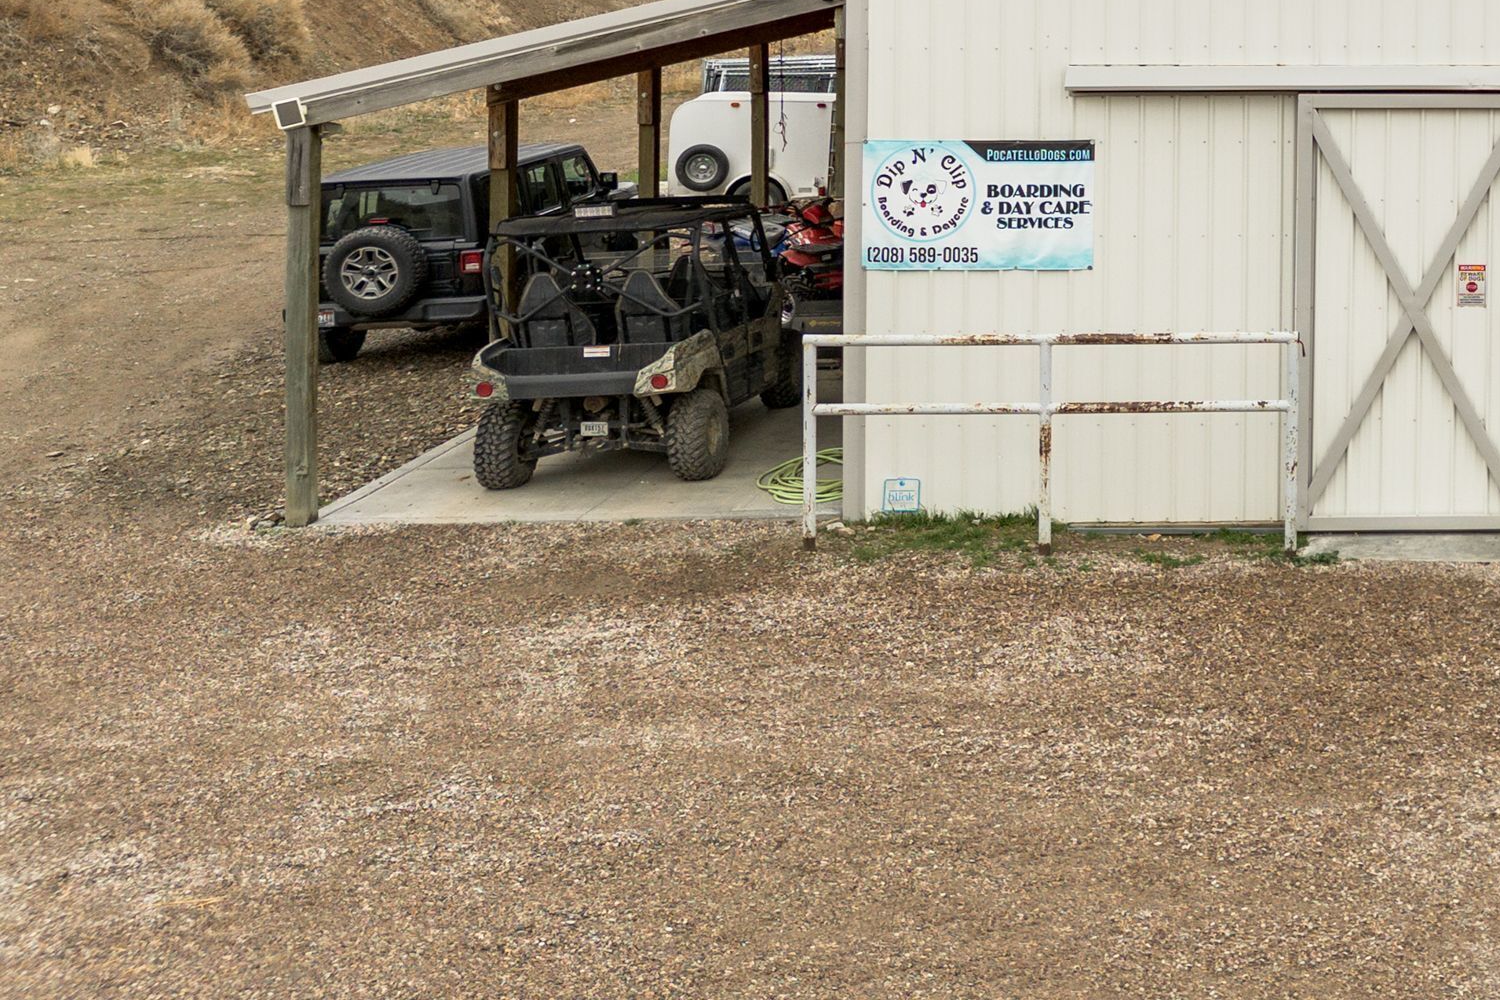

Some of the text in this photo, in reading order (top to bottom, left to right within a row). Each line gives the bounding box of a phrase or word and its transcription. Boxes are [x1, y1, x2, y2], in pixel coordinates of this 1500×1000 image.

[876, 160, 905, 189] Dip
[941, 155, 967, 189] Clip
[987, 184, 1085, 198] BOARDING
[981, 200, 1093, 215] & DAY CARE
[878, 197, 969, 237] Boarding & Daycare
[996, 217, 1074, 229] SERVICES
[867, 247, 979, 263] (208) 589-0035
[888, 492, 915, 501] blink
